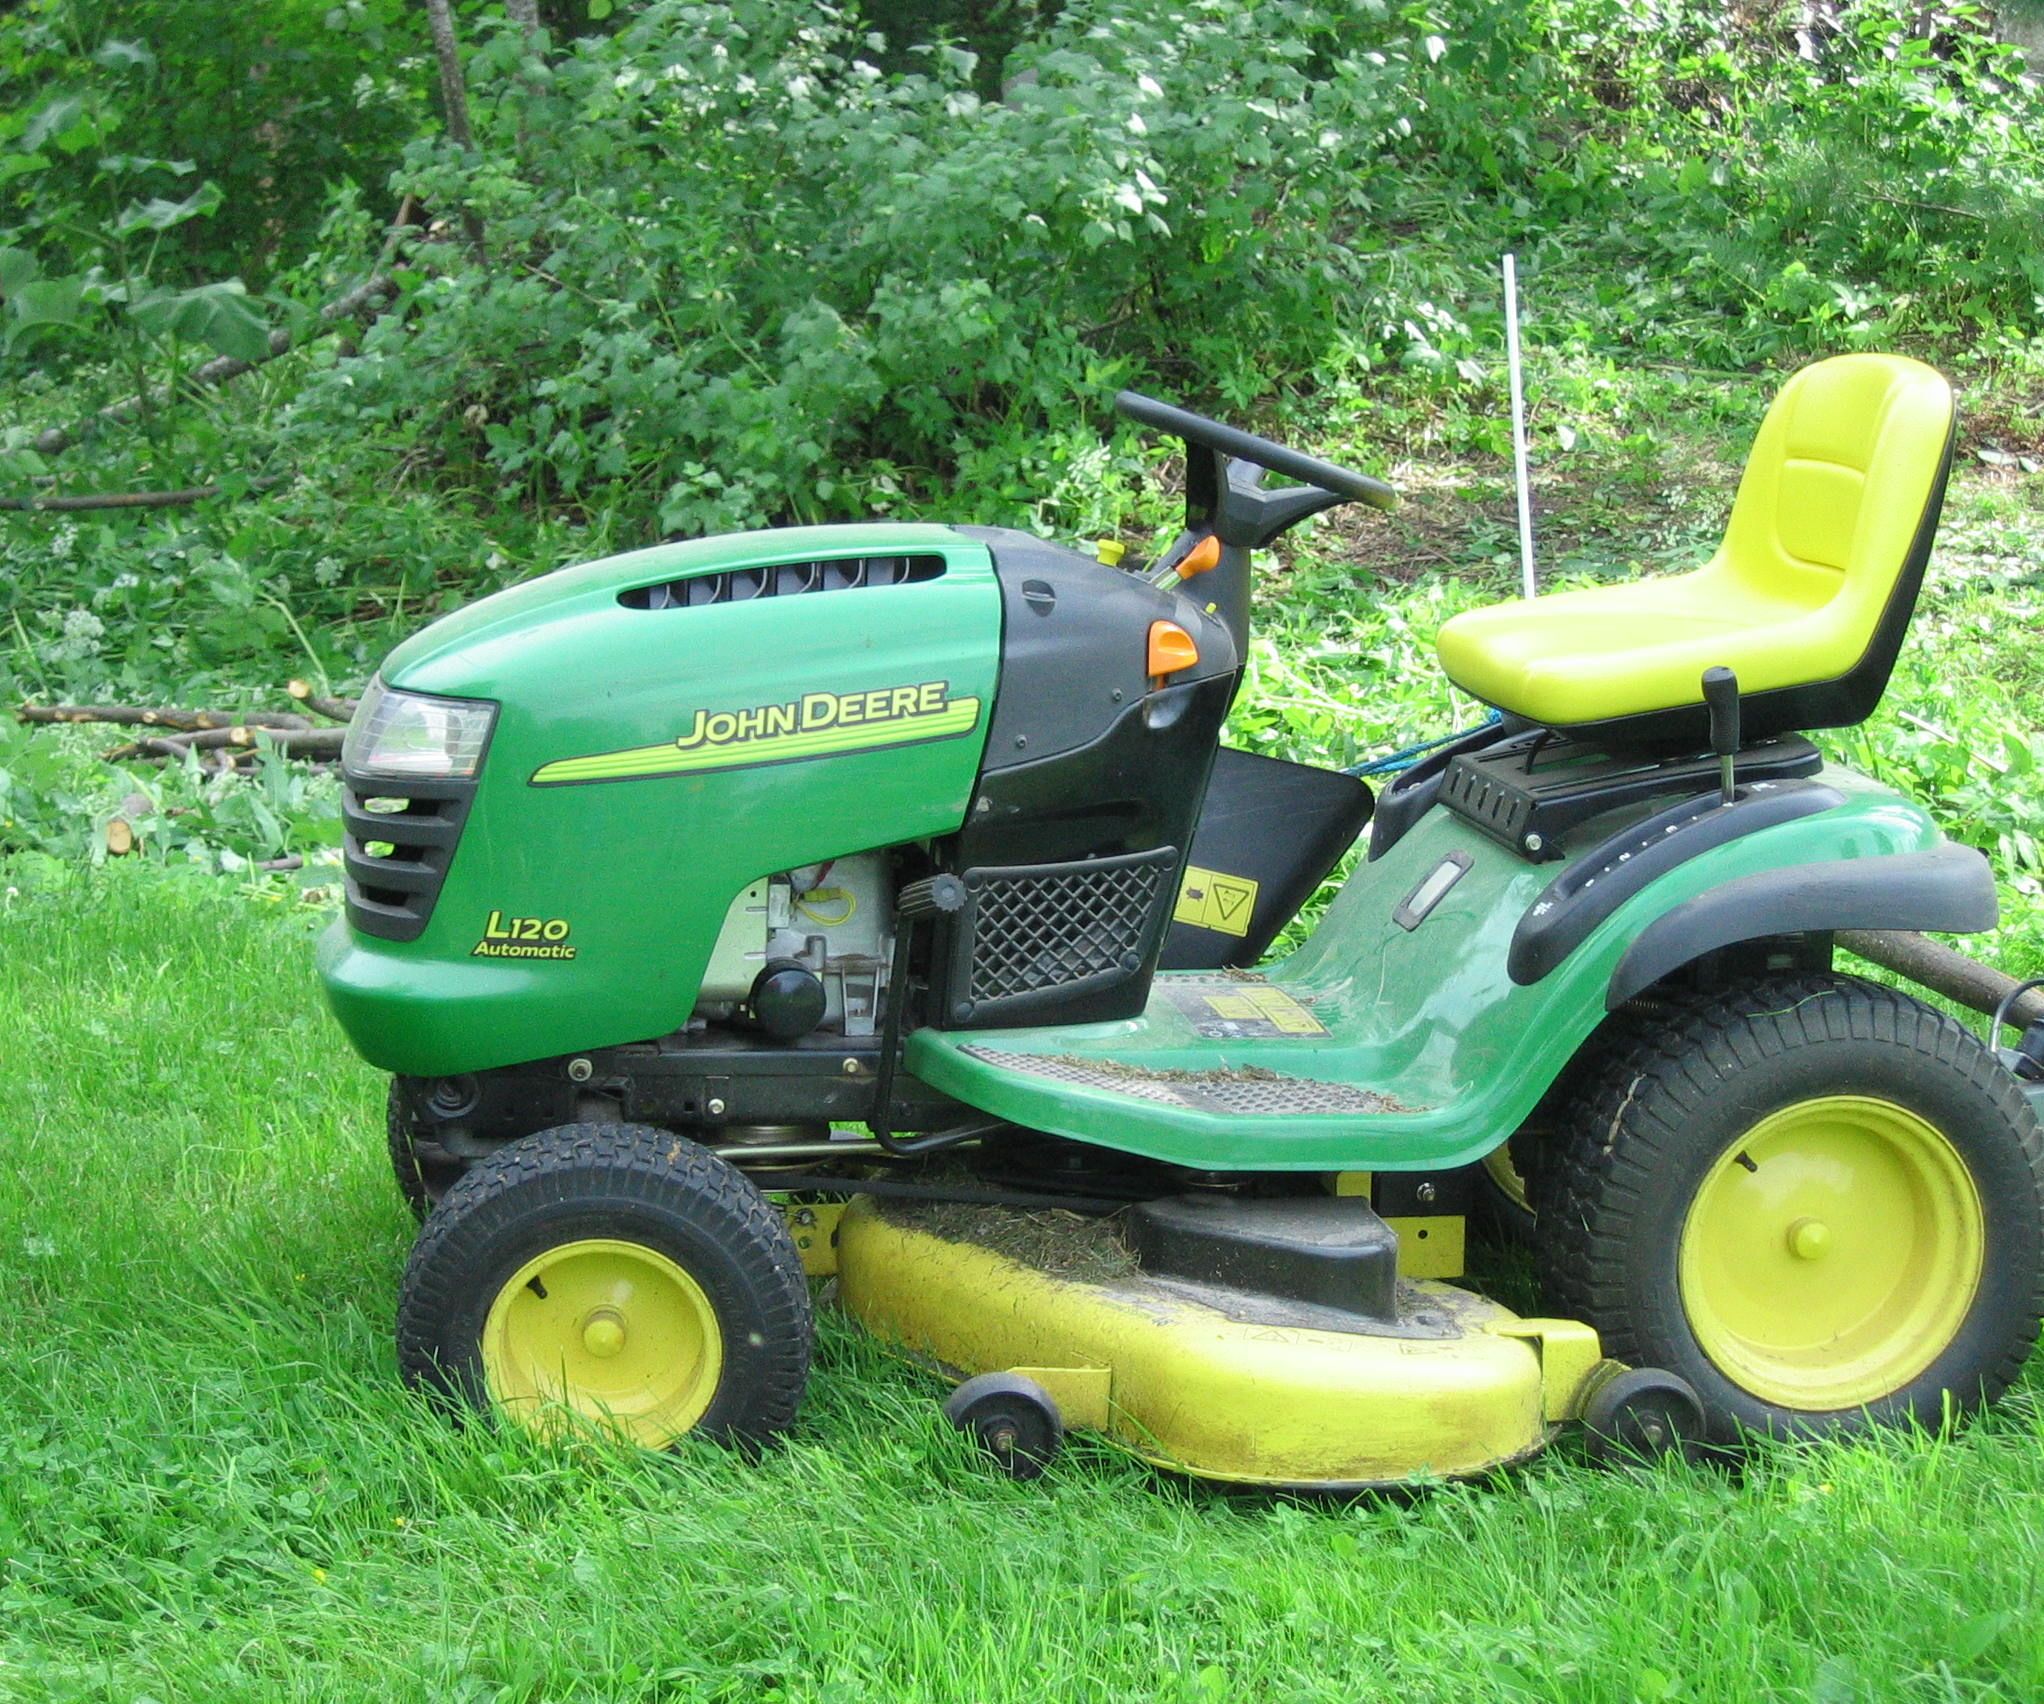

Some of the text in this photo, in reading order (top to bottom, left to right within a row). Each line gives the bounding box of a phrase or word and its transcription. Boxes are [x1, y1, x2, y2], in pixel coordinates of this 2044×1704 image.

[677, 680, 947, 750] JOHN DEERE
[485, 910, 571, 941] L120
[473, 940, 576, 959] Automatic
